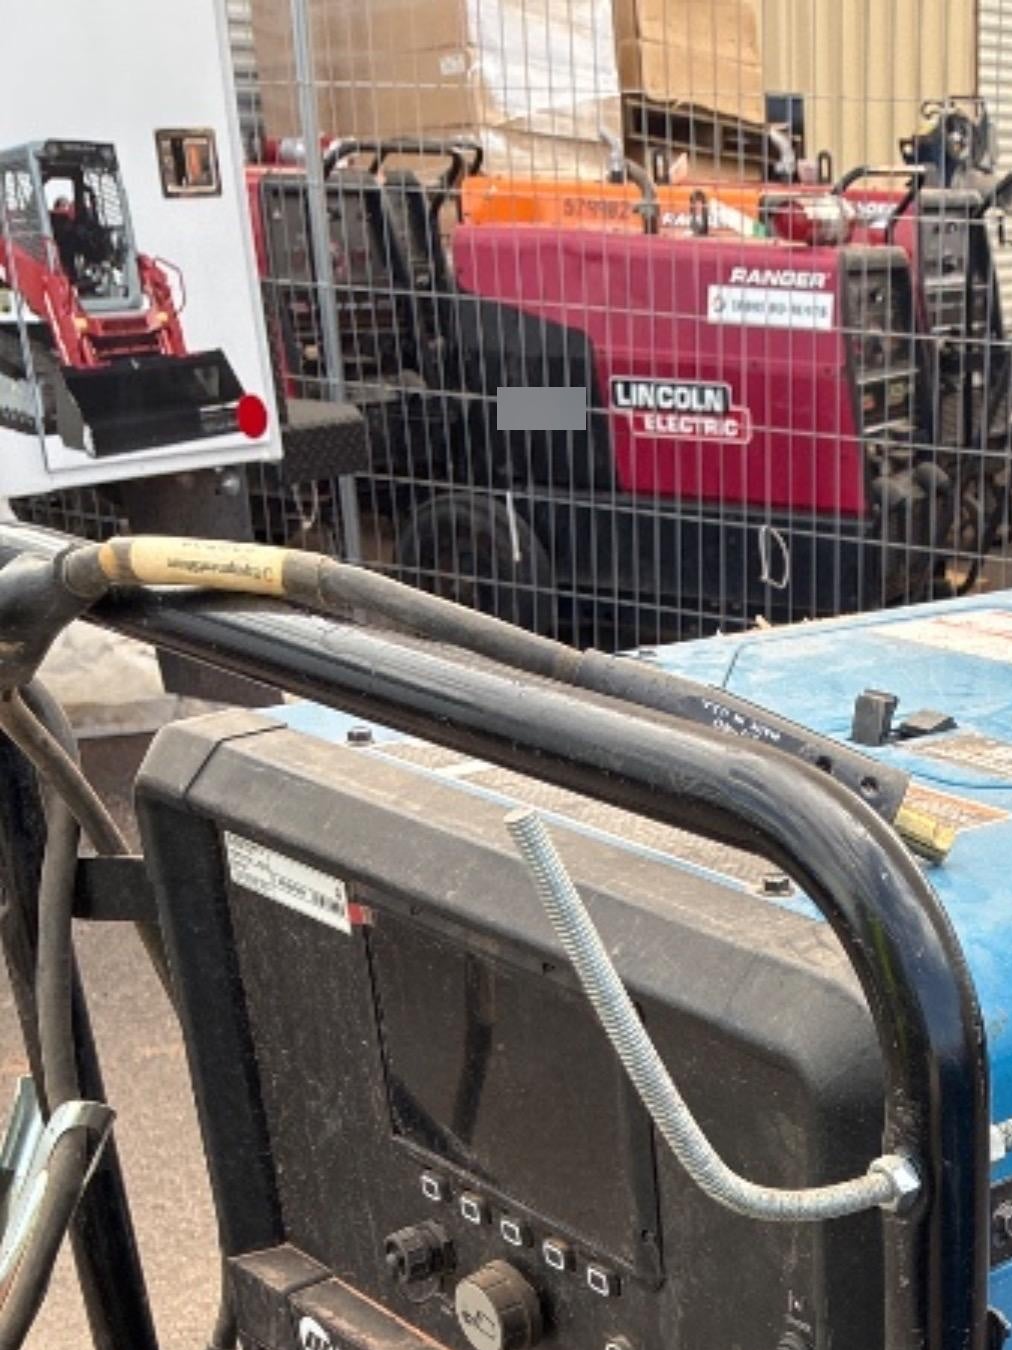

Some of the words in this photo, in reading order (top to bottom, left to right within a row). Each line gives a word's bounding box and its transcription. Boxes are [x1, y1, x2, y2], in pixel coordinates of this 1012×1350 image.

[730, 266, 826, 289] RANGER
[615, 382, 725, 412] LINCOLN
[643, 415, 739, 438] ELECTRIC
